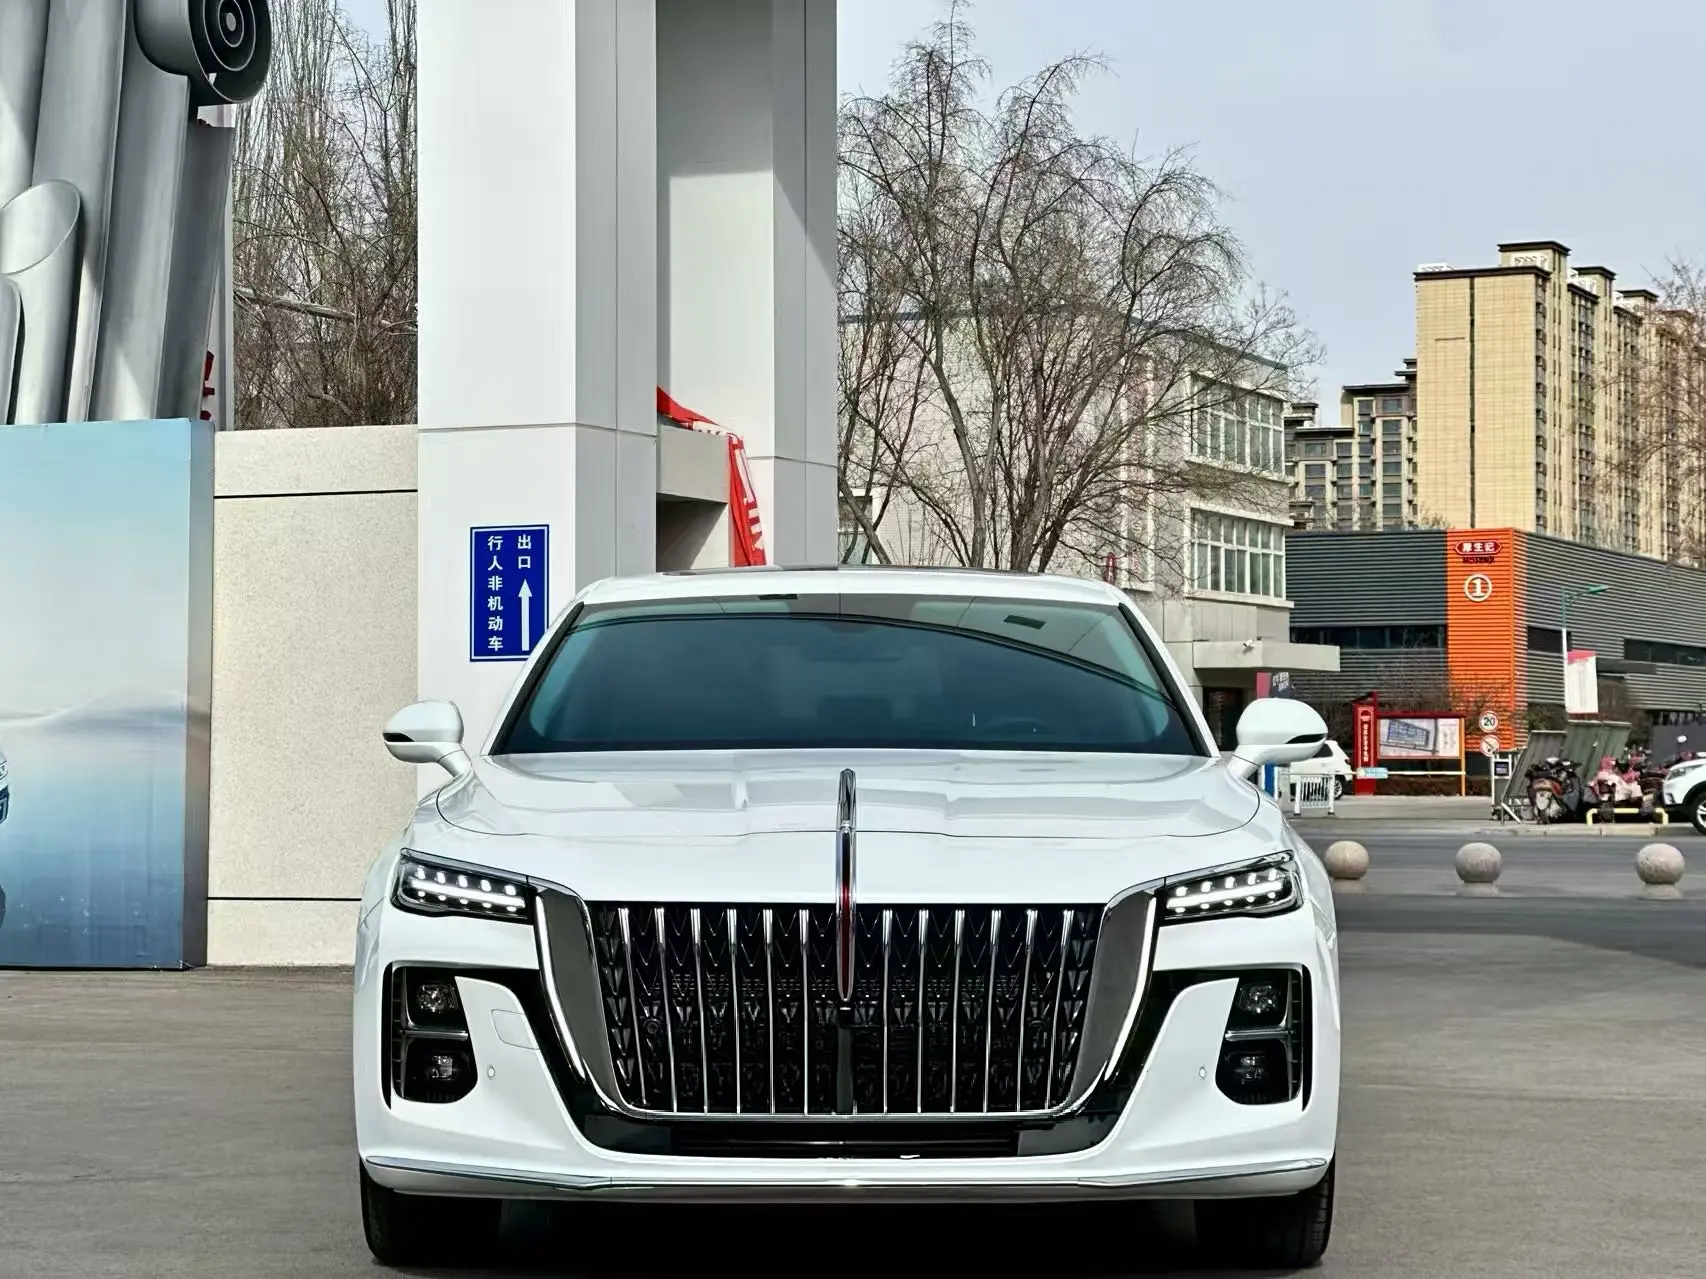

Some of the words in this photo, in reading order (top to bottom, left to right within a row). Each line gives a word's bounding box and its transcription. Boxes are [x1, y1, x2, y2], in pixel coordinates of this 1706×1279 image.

[517, 534, 532, 569] 出口
[487, 535, 503, 651] 行人非机动车
[1484, 717, 1495, 726] 20
